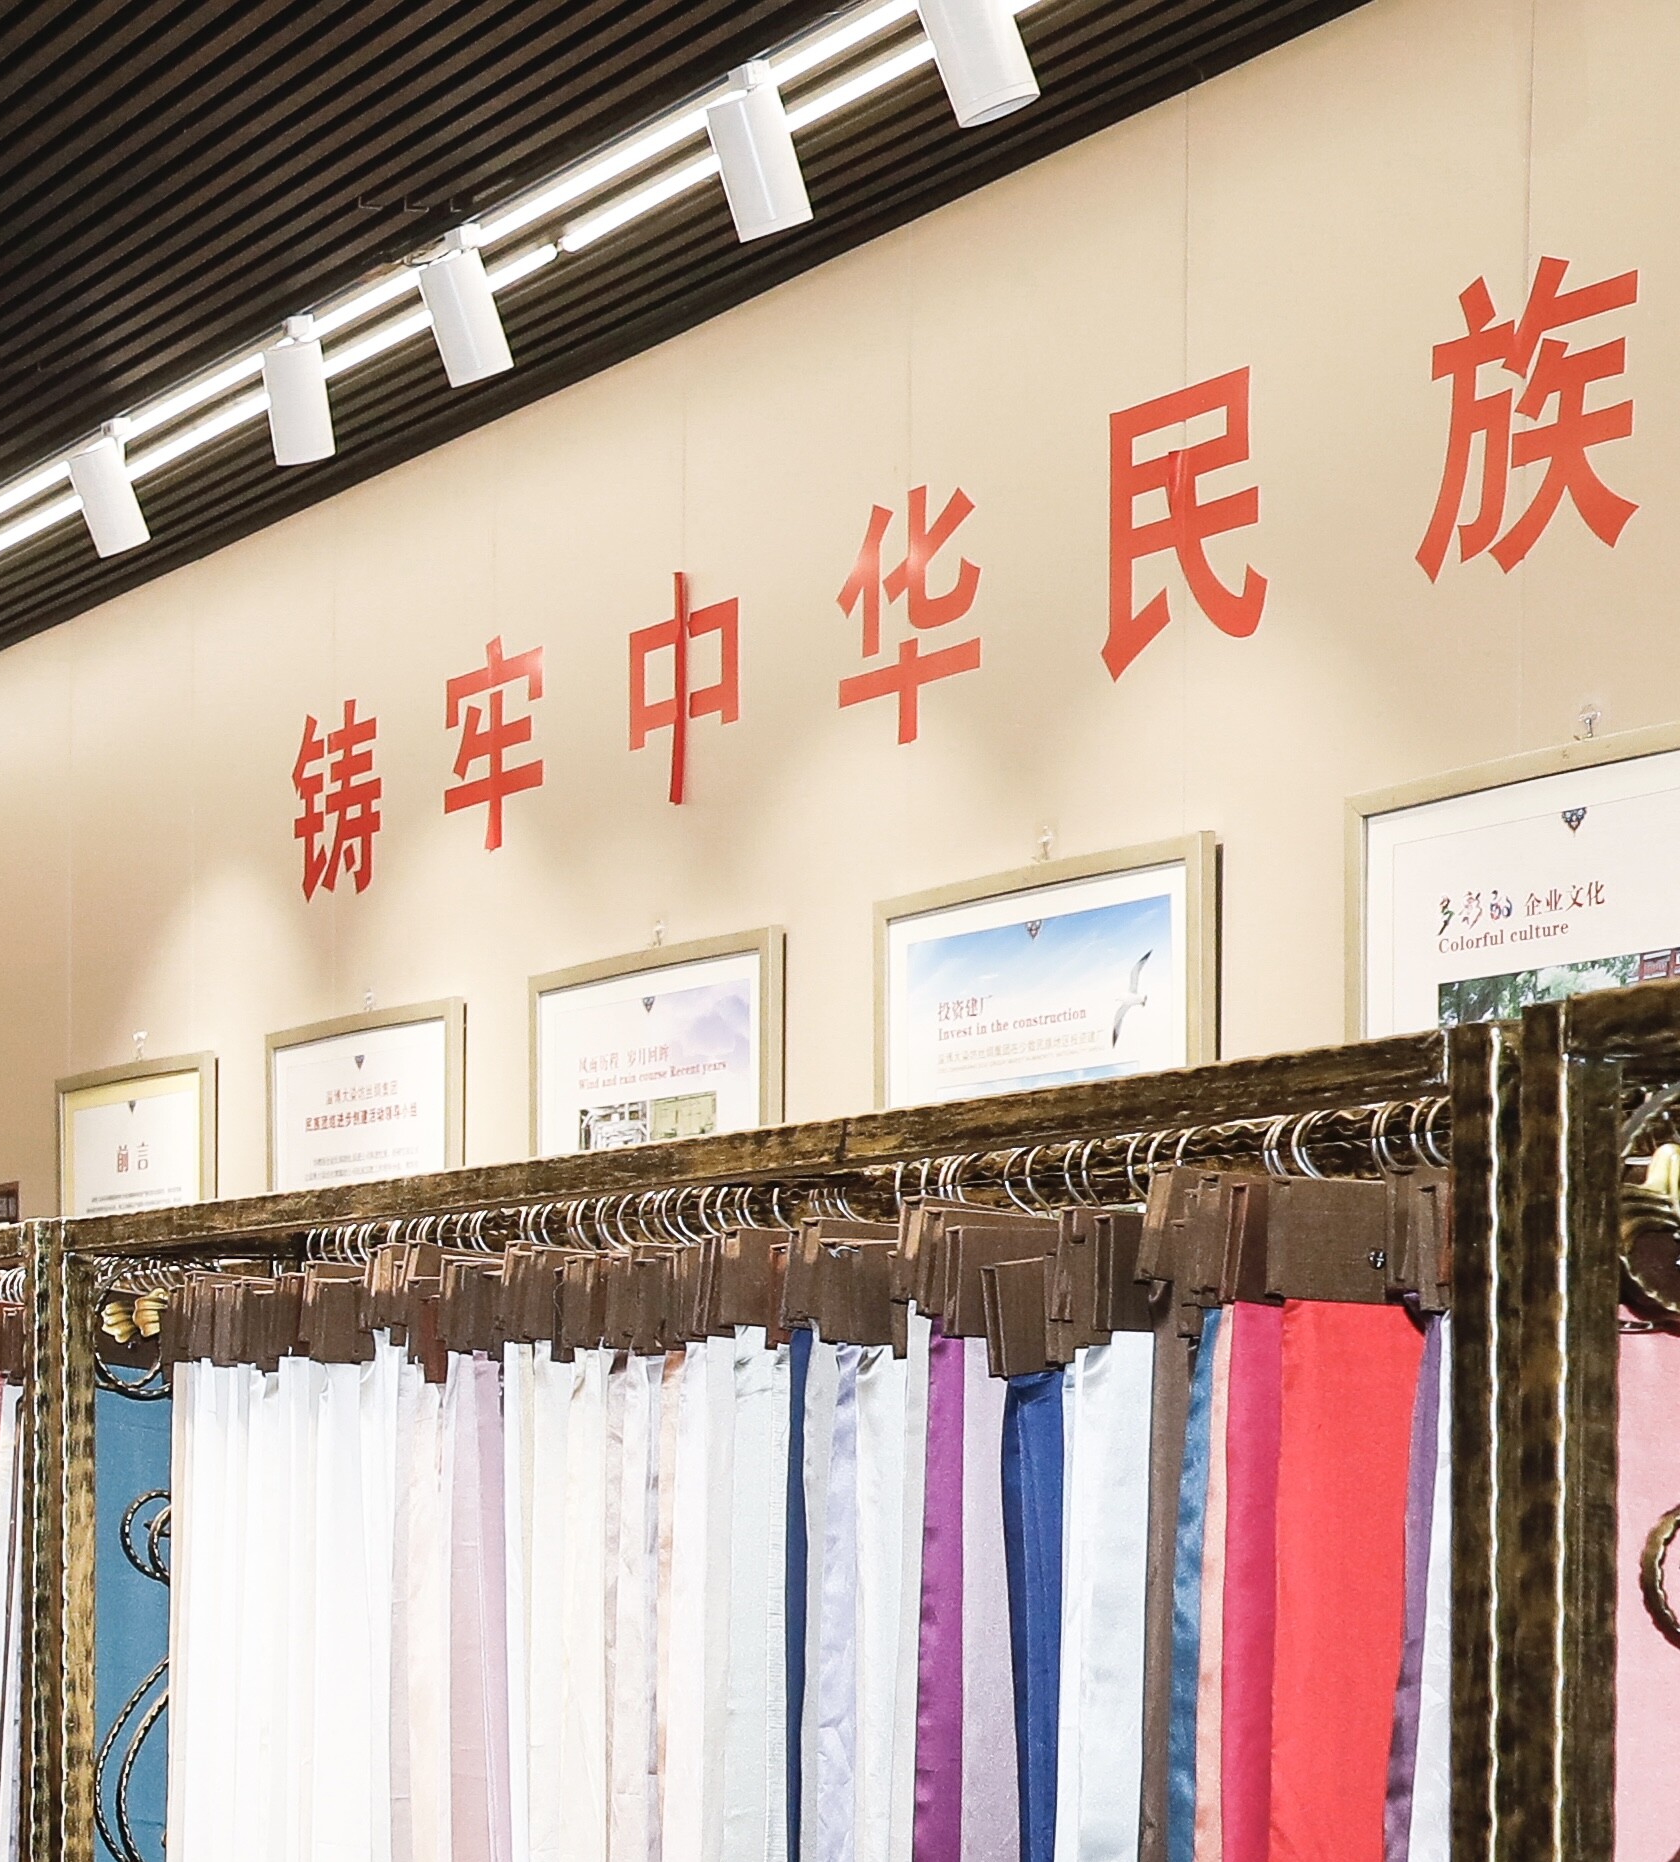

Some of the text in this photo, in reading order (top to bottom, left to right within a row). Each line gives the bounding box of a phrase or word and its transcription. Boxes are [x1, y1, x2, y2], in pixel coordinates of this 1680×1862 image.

[291, 255, 1640, 904] 铸牢中华民族
[1524, 880, 1606, 918] 企业文化
[1437, 921, 1570, 954] Colorful culture
[937, 994, 994, 1022] 投资建厂
[937, 1007, 1087, 1042] Invest in the construction
[578, 1061, 727, 1091] Wind and rain course Recent years
